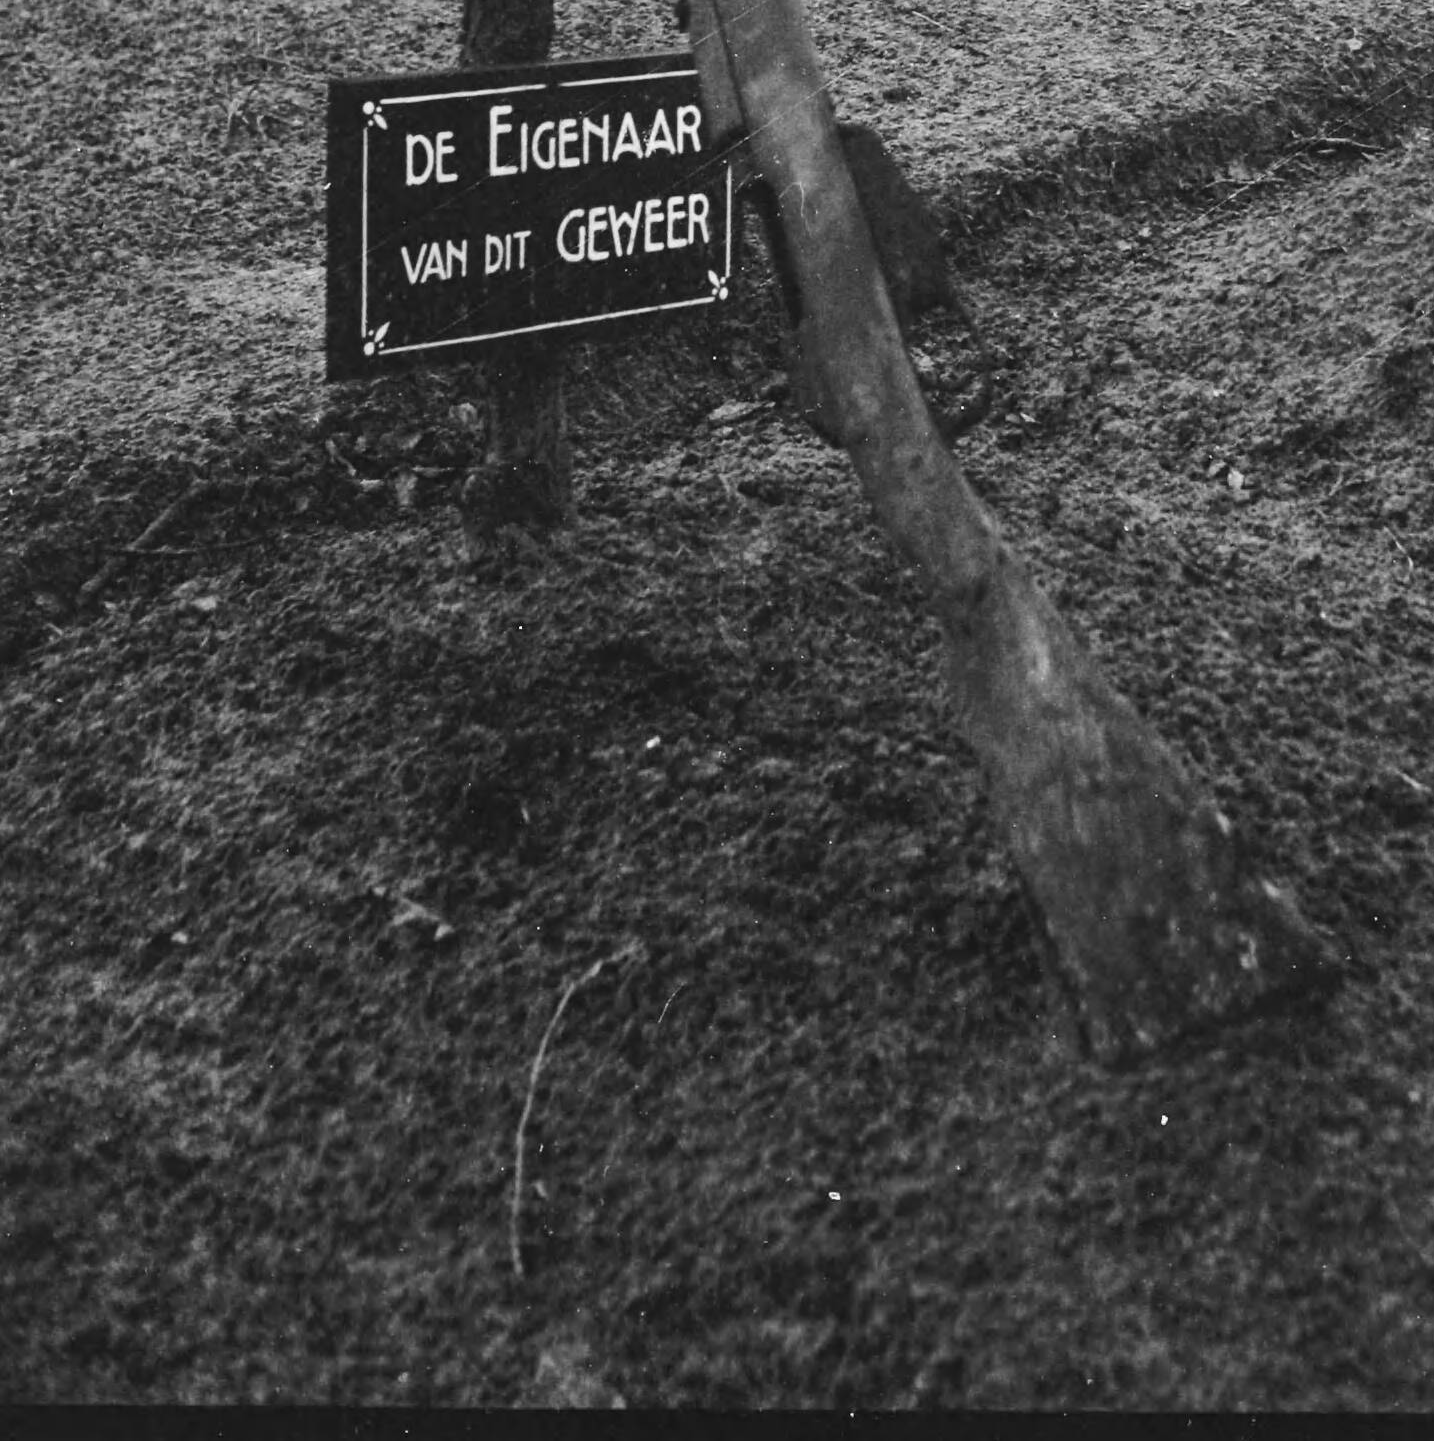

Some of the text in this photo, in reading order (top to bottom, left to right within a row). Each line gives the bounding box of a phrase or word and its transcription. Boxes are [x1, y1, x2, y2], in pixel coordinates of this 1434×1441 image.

[405, 105, 702, 186] DE EIGENAAR
[401, 193, 710, 286] VAN DIT GEWEER
